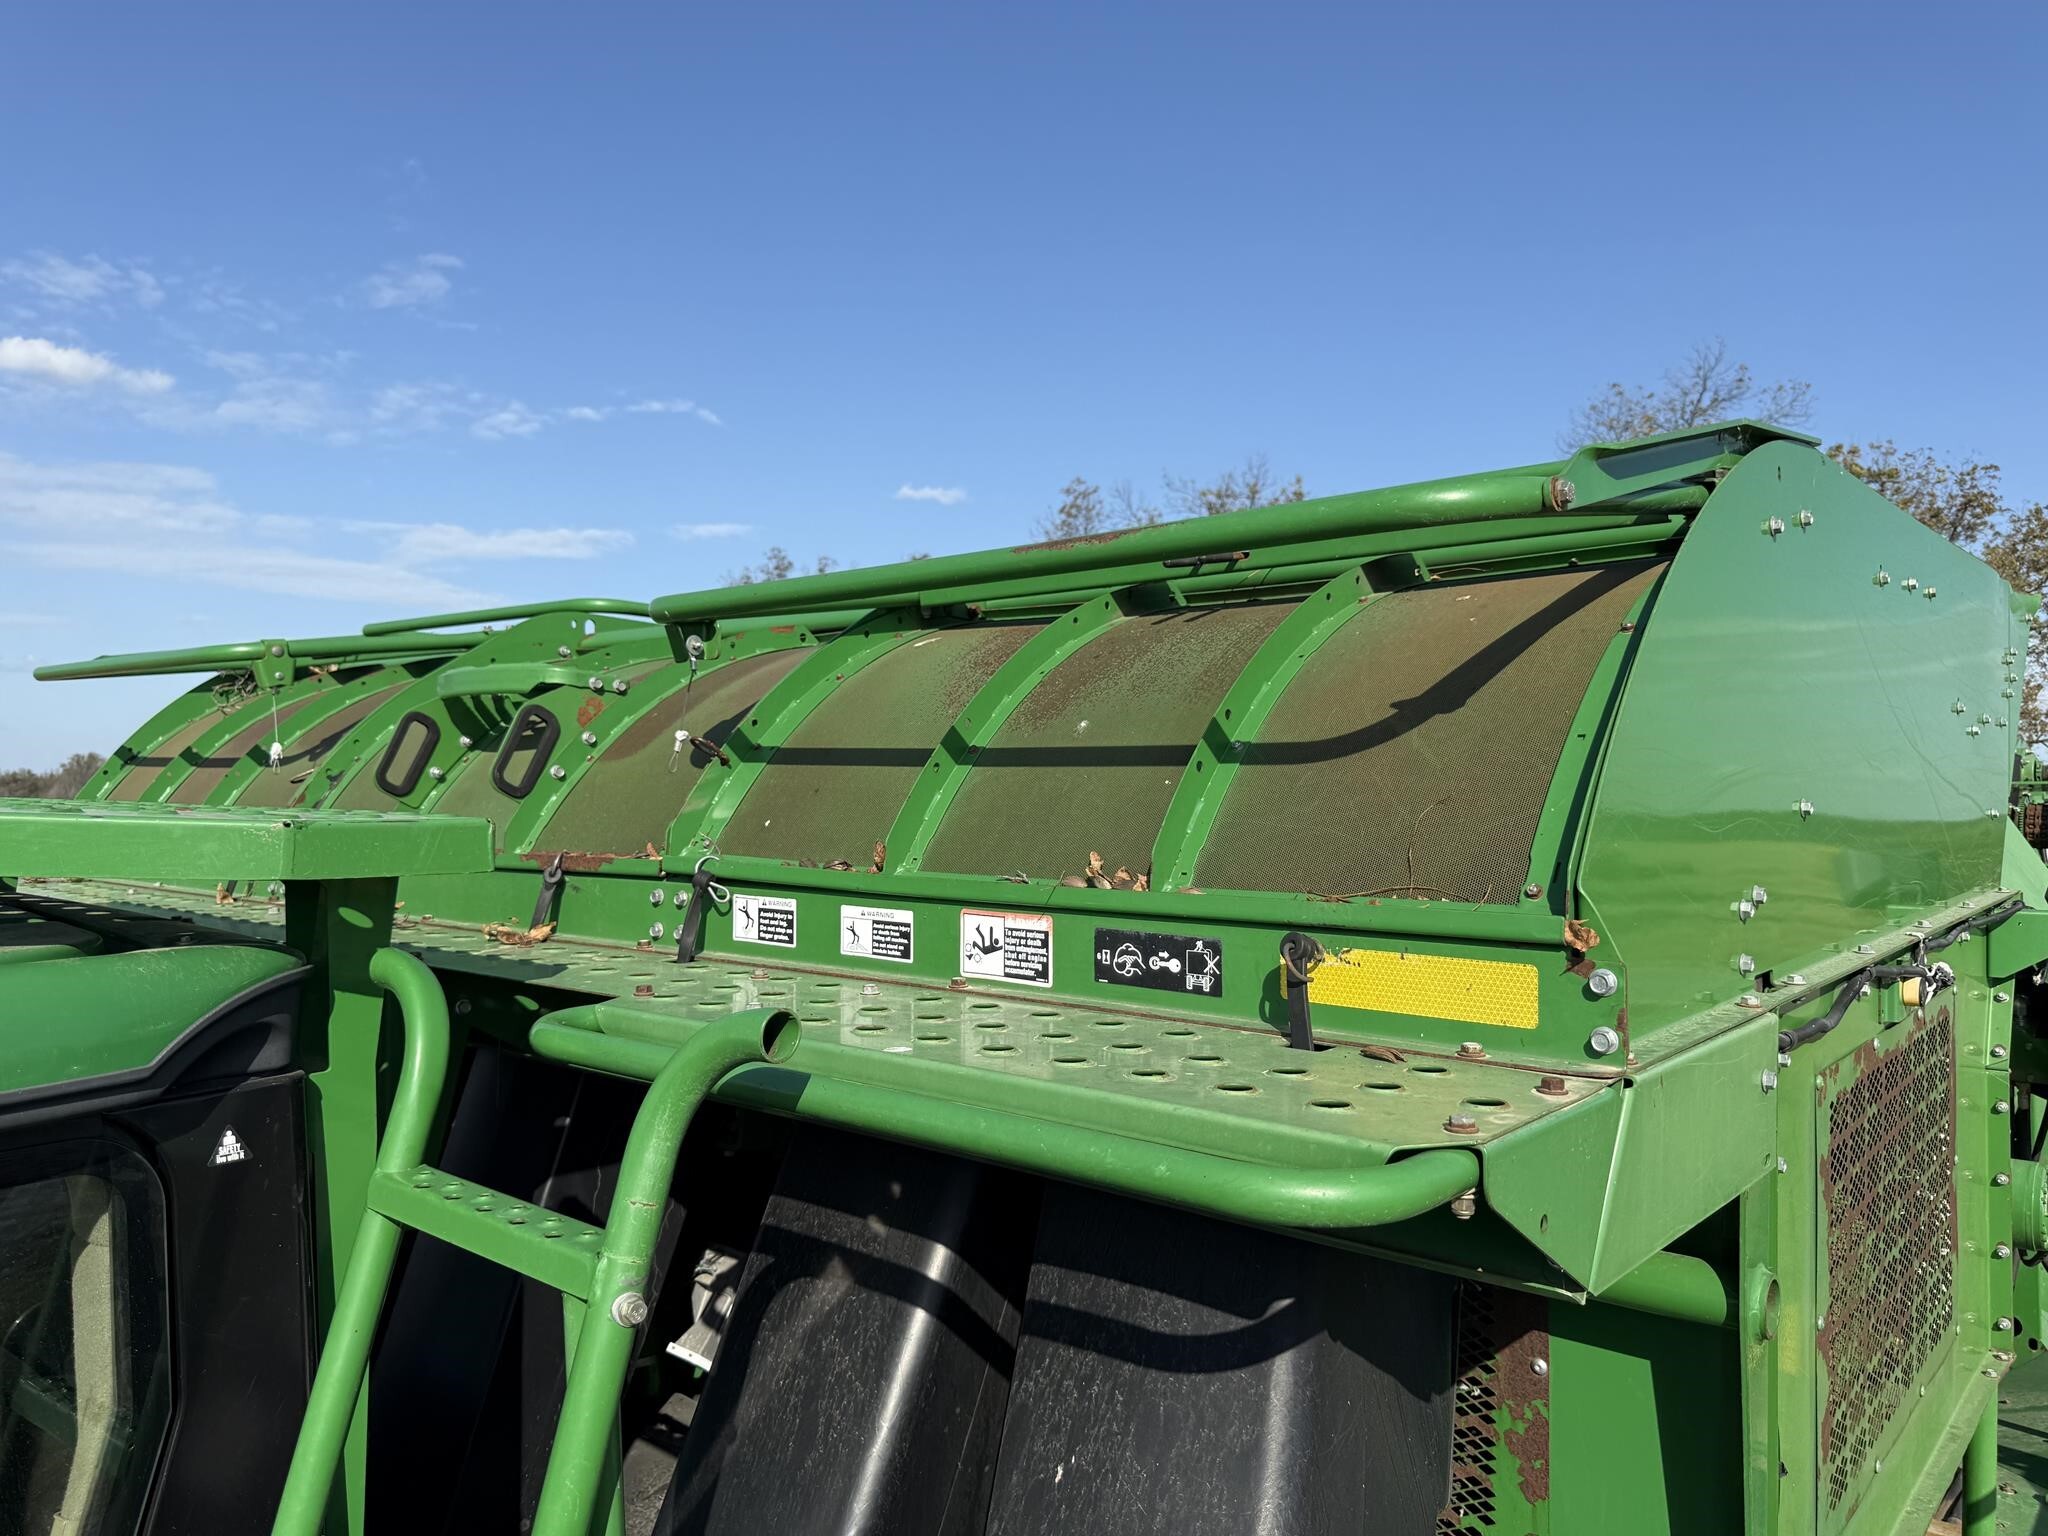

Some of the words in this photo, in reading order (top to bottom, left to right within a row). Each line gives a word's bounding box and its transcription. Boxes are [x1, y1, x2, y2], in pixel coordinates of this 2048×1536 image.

[866, 911, 895, 919] WARNING
[1012, 930, 1026, 938] avoid
[1026, 931, 1045, 939] serious
[1005, 936, 1020, 945] injury
[1005, 943, 1015, 951] from
[1027, 955, 1047, 963] engine
[1005, 958, 1020, 967] before
[1020, 961, 1042, 971] servicing
[218, 1143, 241, 1155] SAFETY
